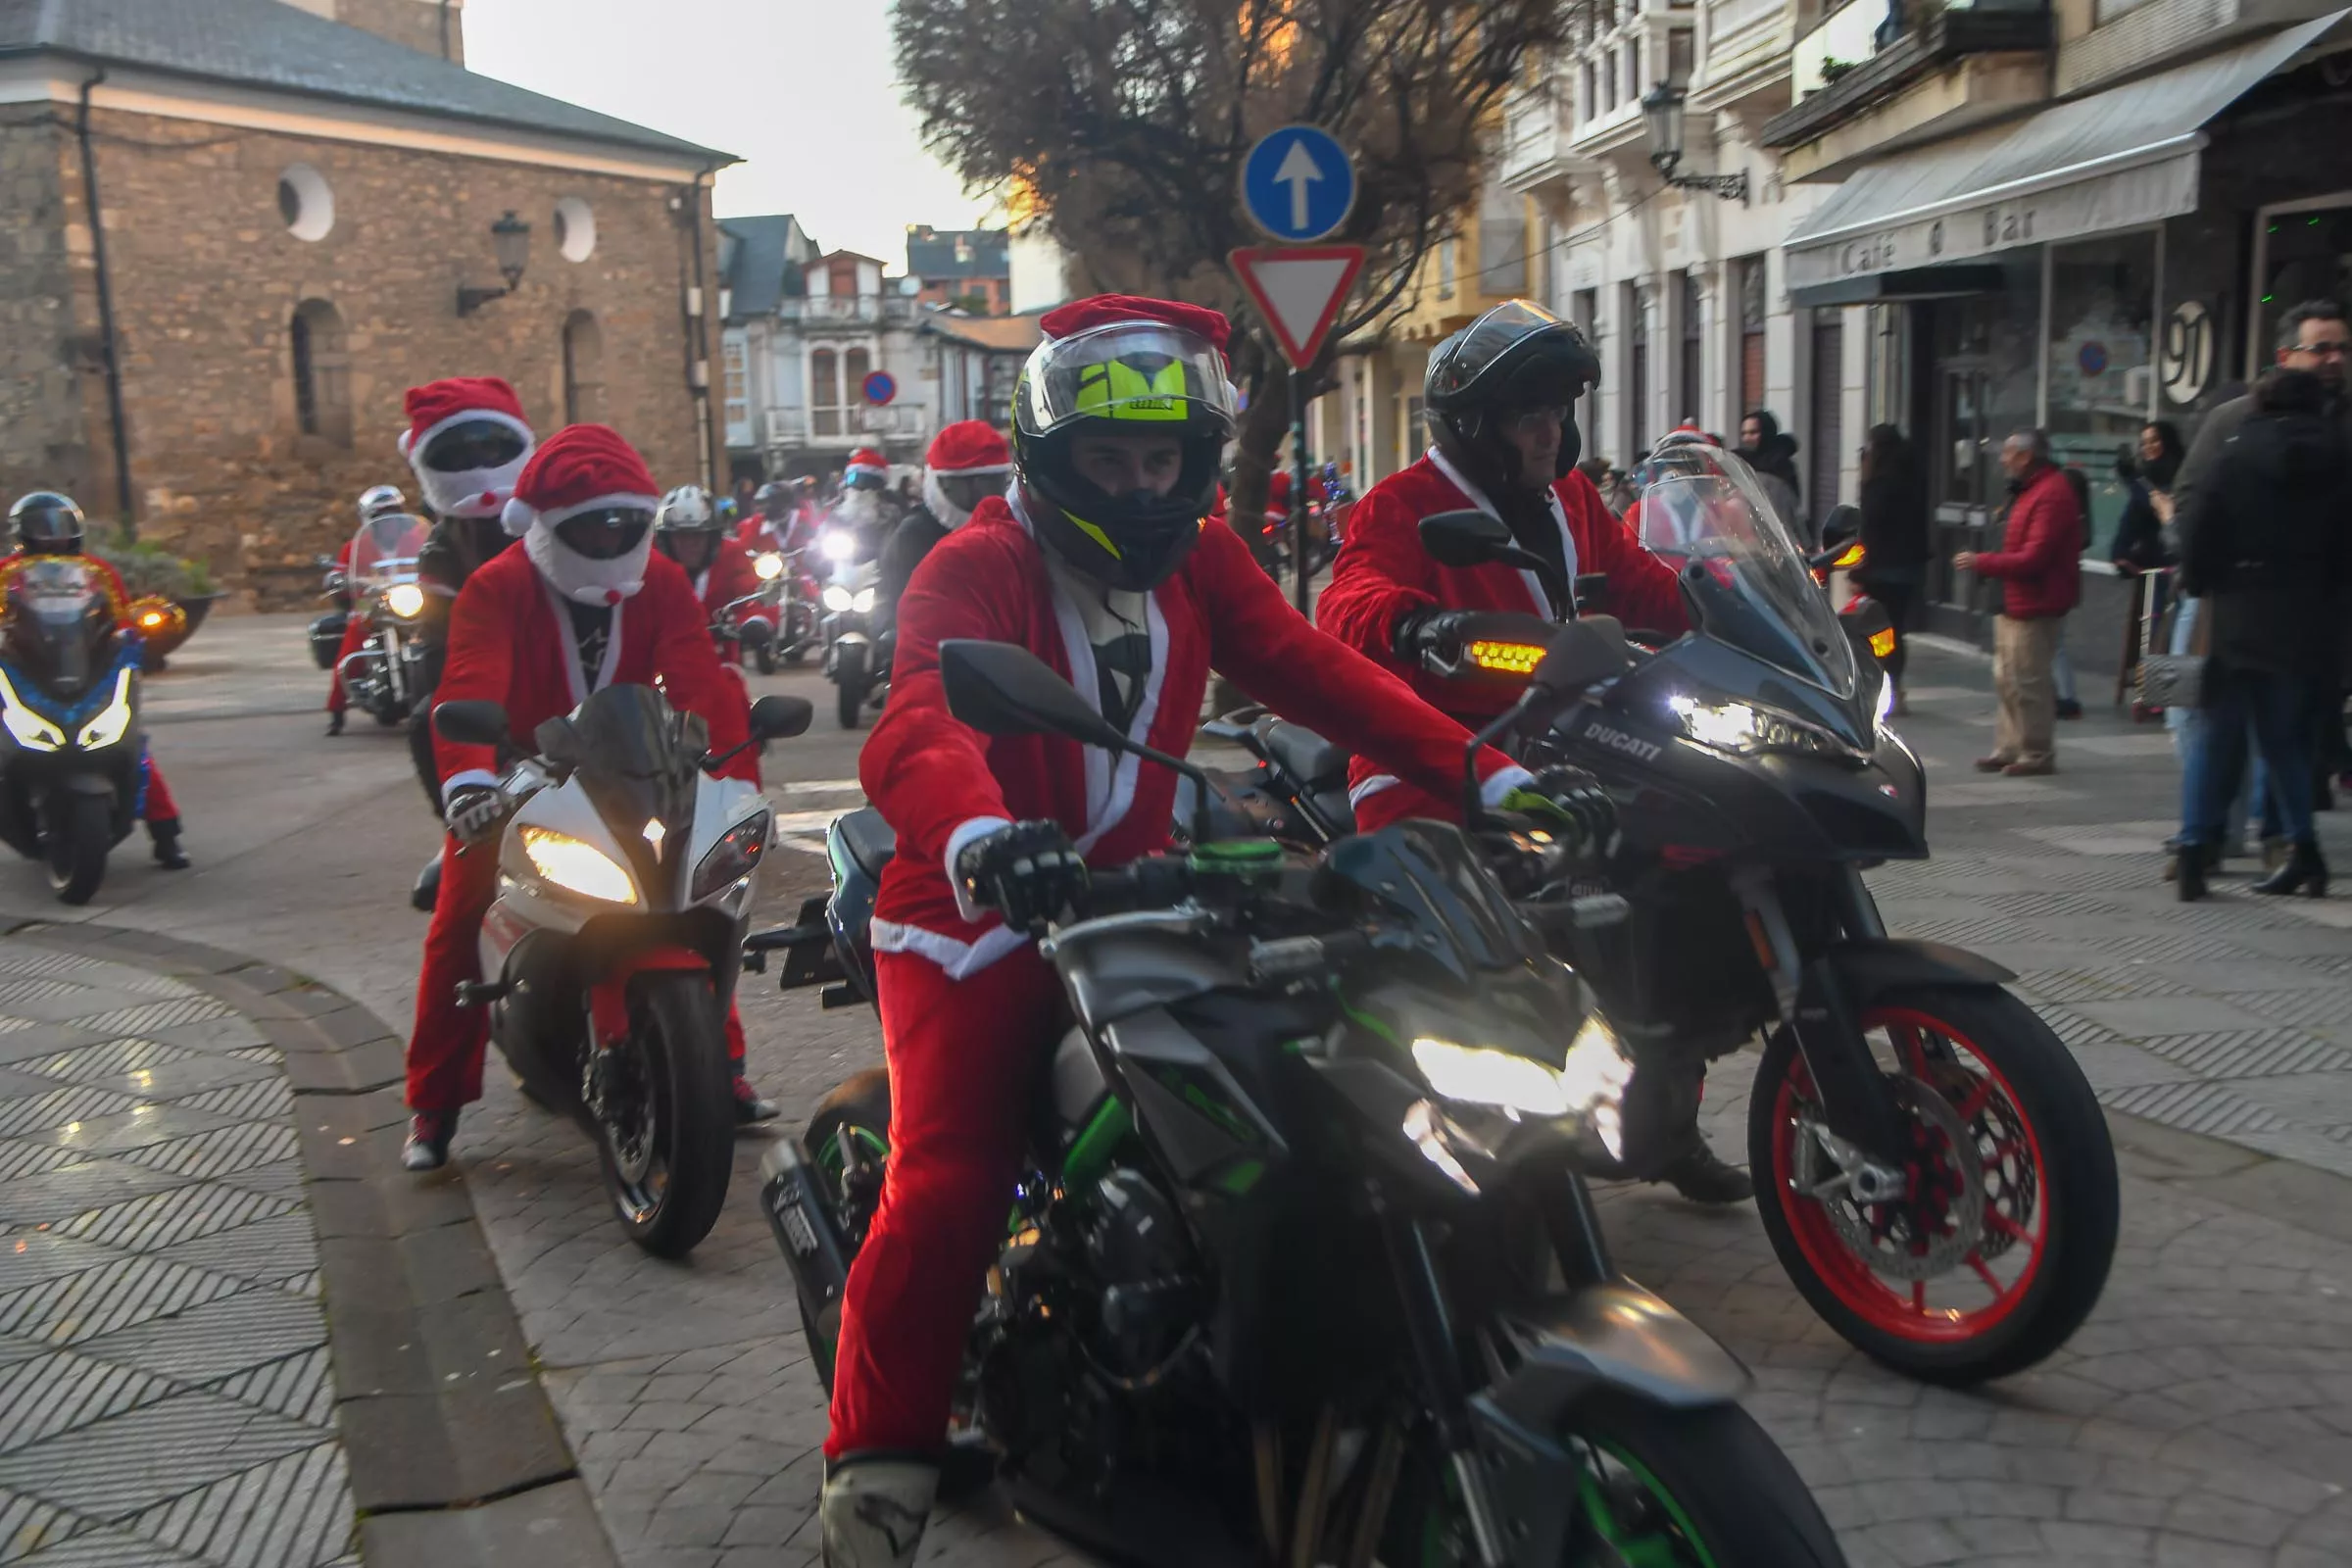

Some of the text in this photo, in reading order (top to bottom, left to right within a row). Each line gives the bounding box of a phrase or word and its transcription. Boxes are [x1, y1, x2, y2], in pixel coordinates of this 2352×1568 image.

[1984, 208, 2036, 247] Bar
[2162, 311, 2202, 388] 91
[1584, 722, 1662, 761] DUCATI
